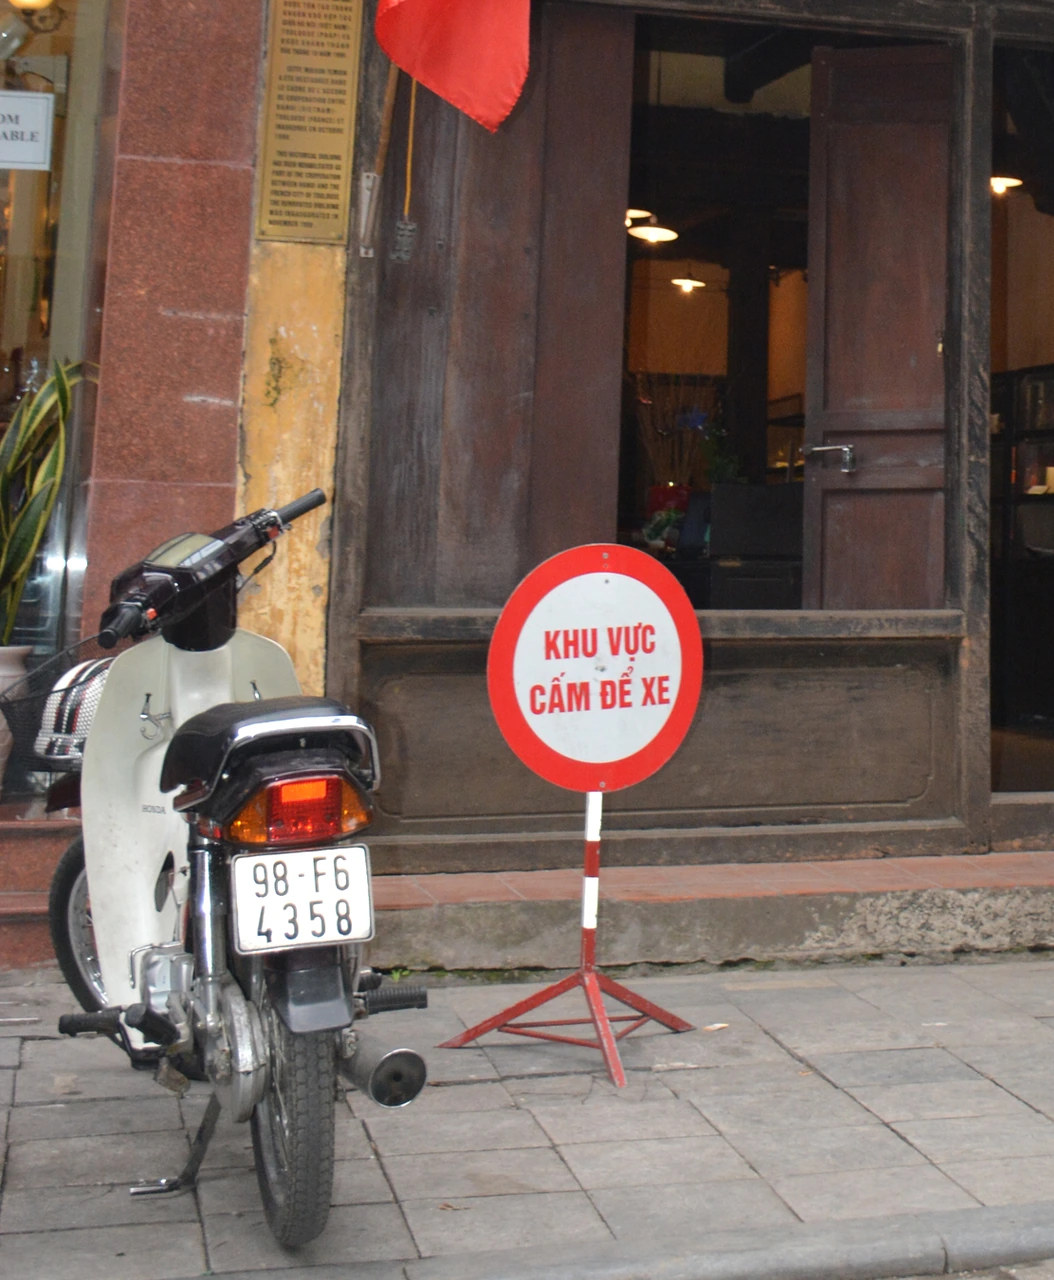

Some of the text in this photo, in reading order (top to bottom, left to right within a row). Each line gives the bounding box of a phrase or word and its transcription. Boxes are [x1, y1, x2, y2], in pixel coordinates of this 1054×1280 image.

[544, 622, 656, 662] KHU VỰC
[529, 666, 671, 715] CẤM ĐỂ XE
[257, 898, 353, 943] 4358
